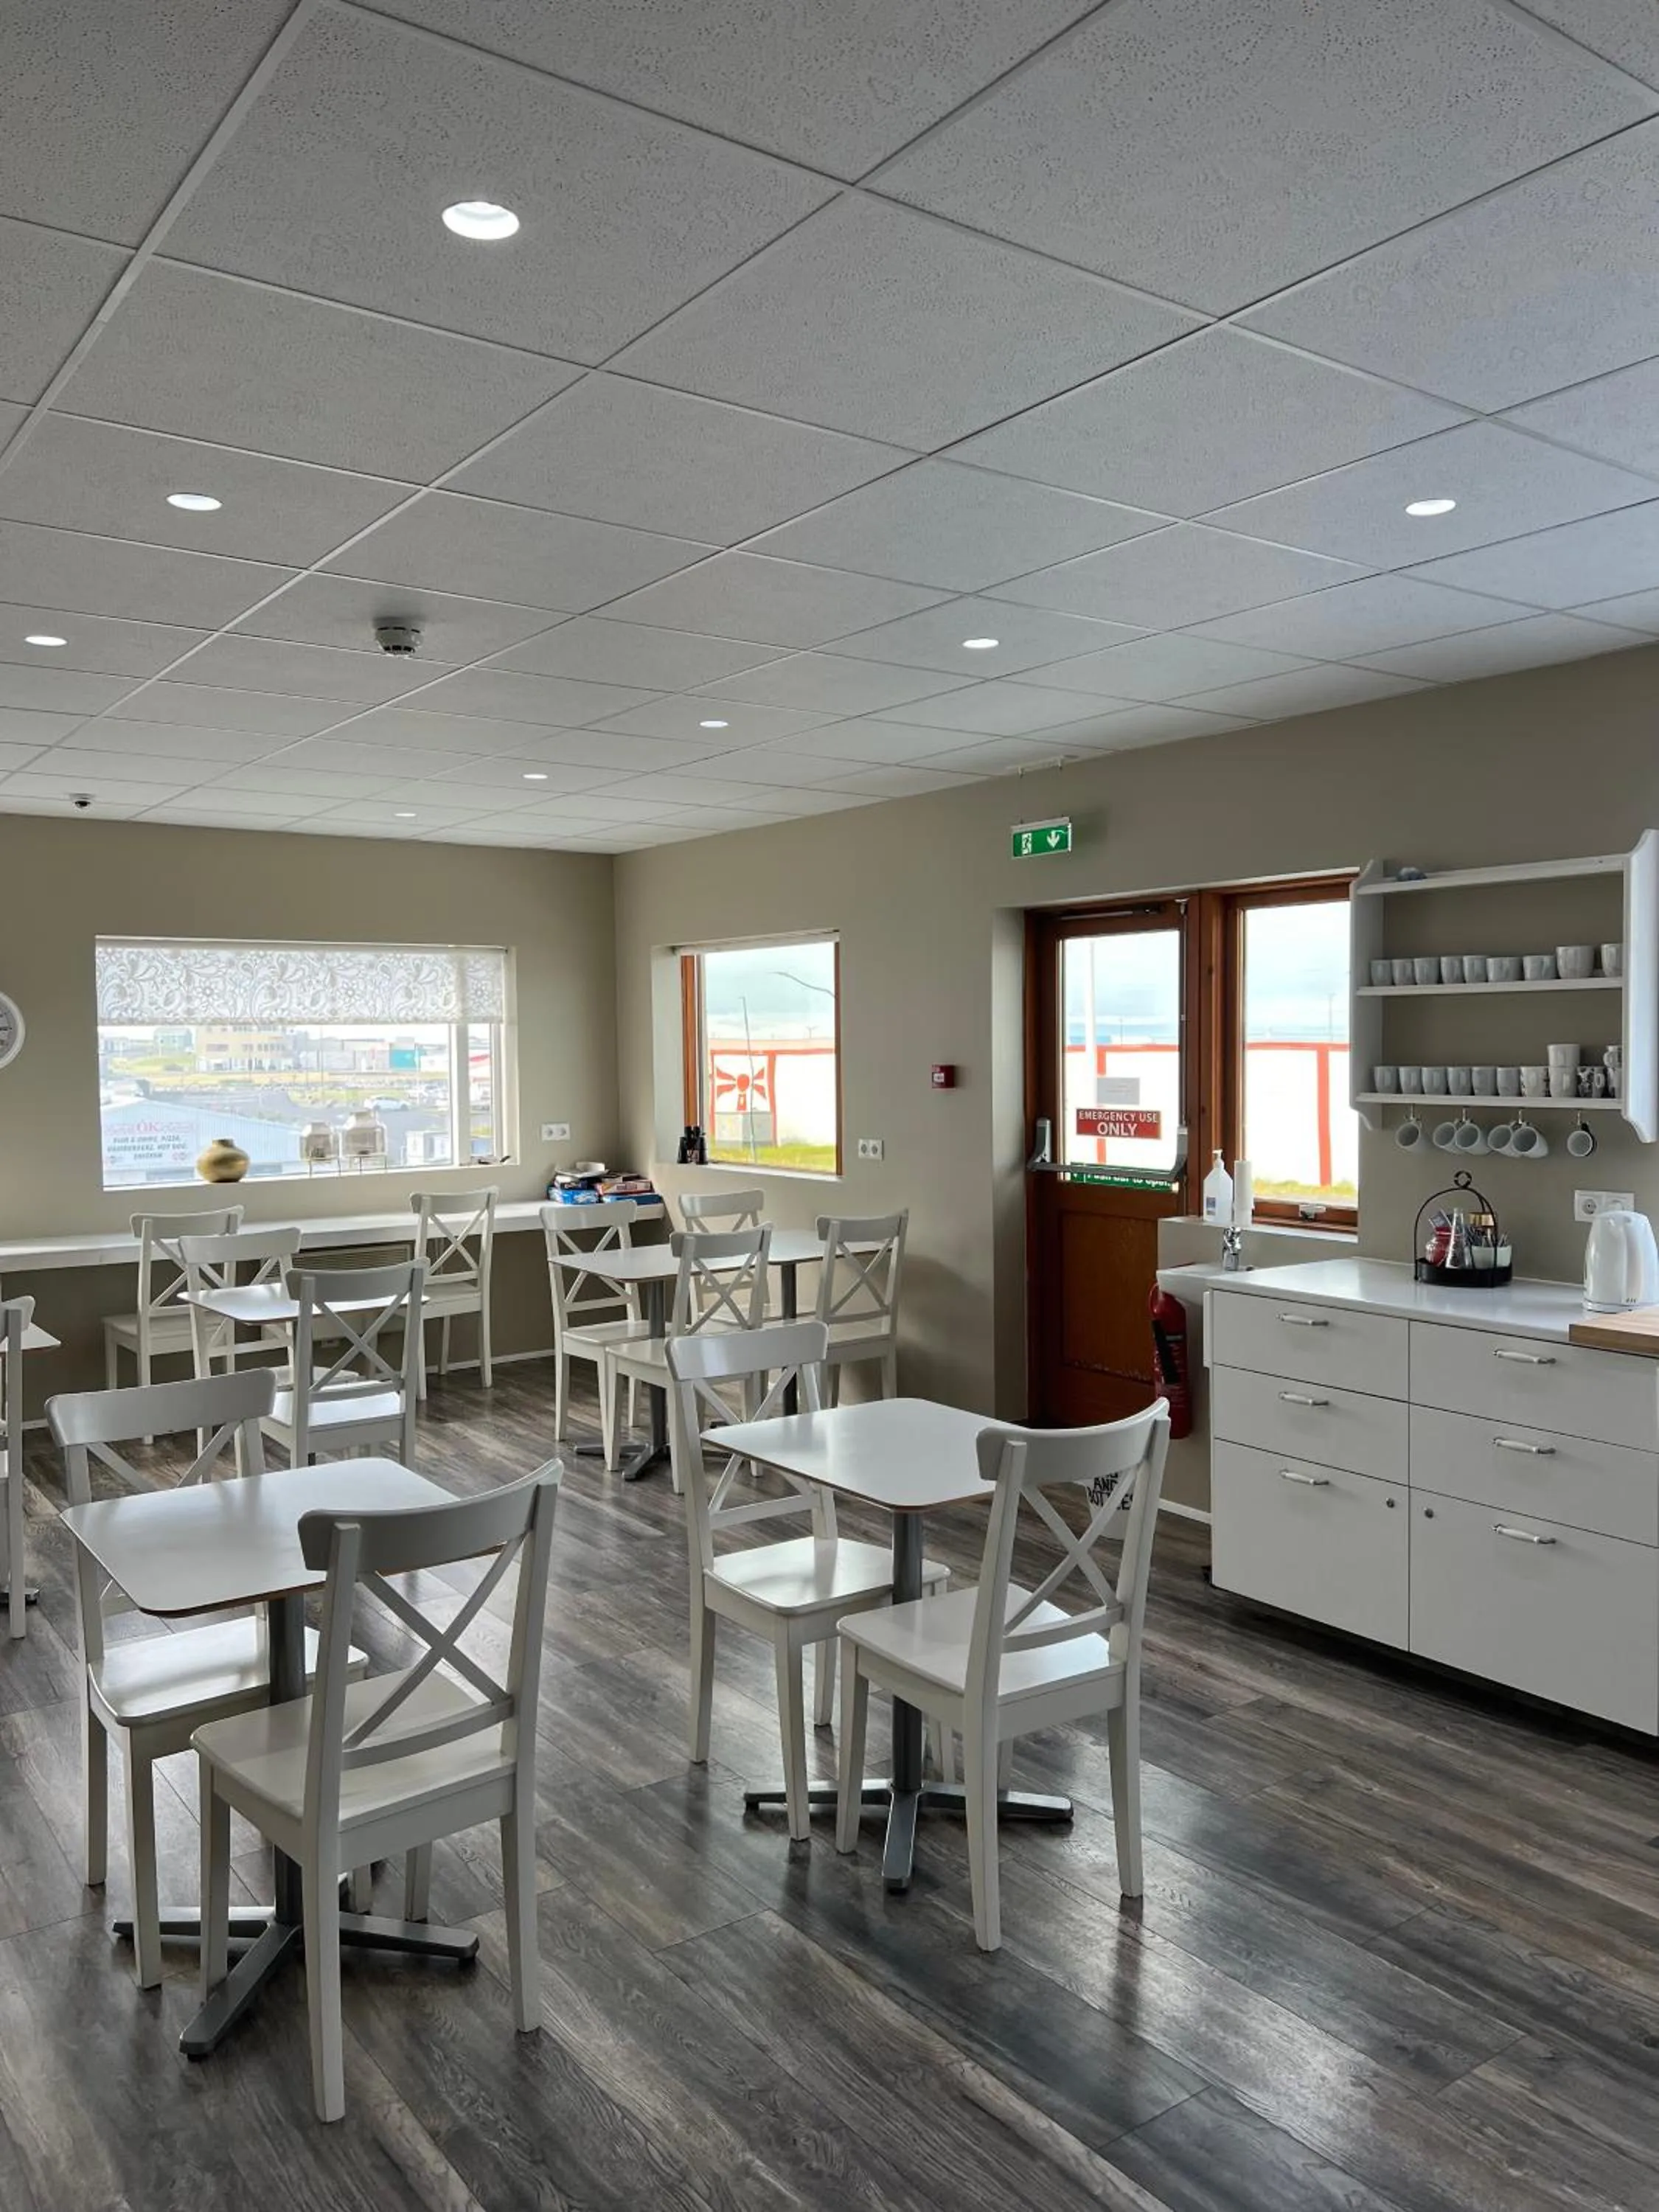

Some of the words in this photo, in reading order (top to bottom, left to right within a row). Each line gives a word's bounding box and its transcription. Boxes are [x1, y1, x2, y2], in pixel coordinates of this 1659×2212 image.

[1079, 1110, 1136, 1121] EMERGENCY
[1139, 1112, 1158, 1123] USE
[1097, 1121, 1138, 1136] ONLY
